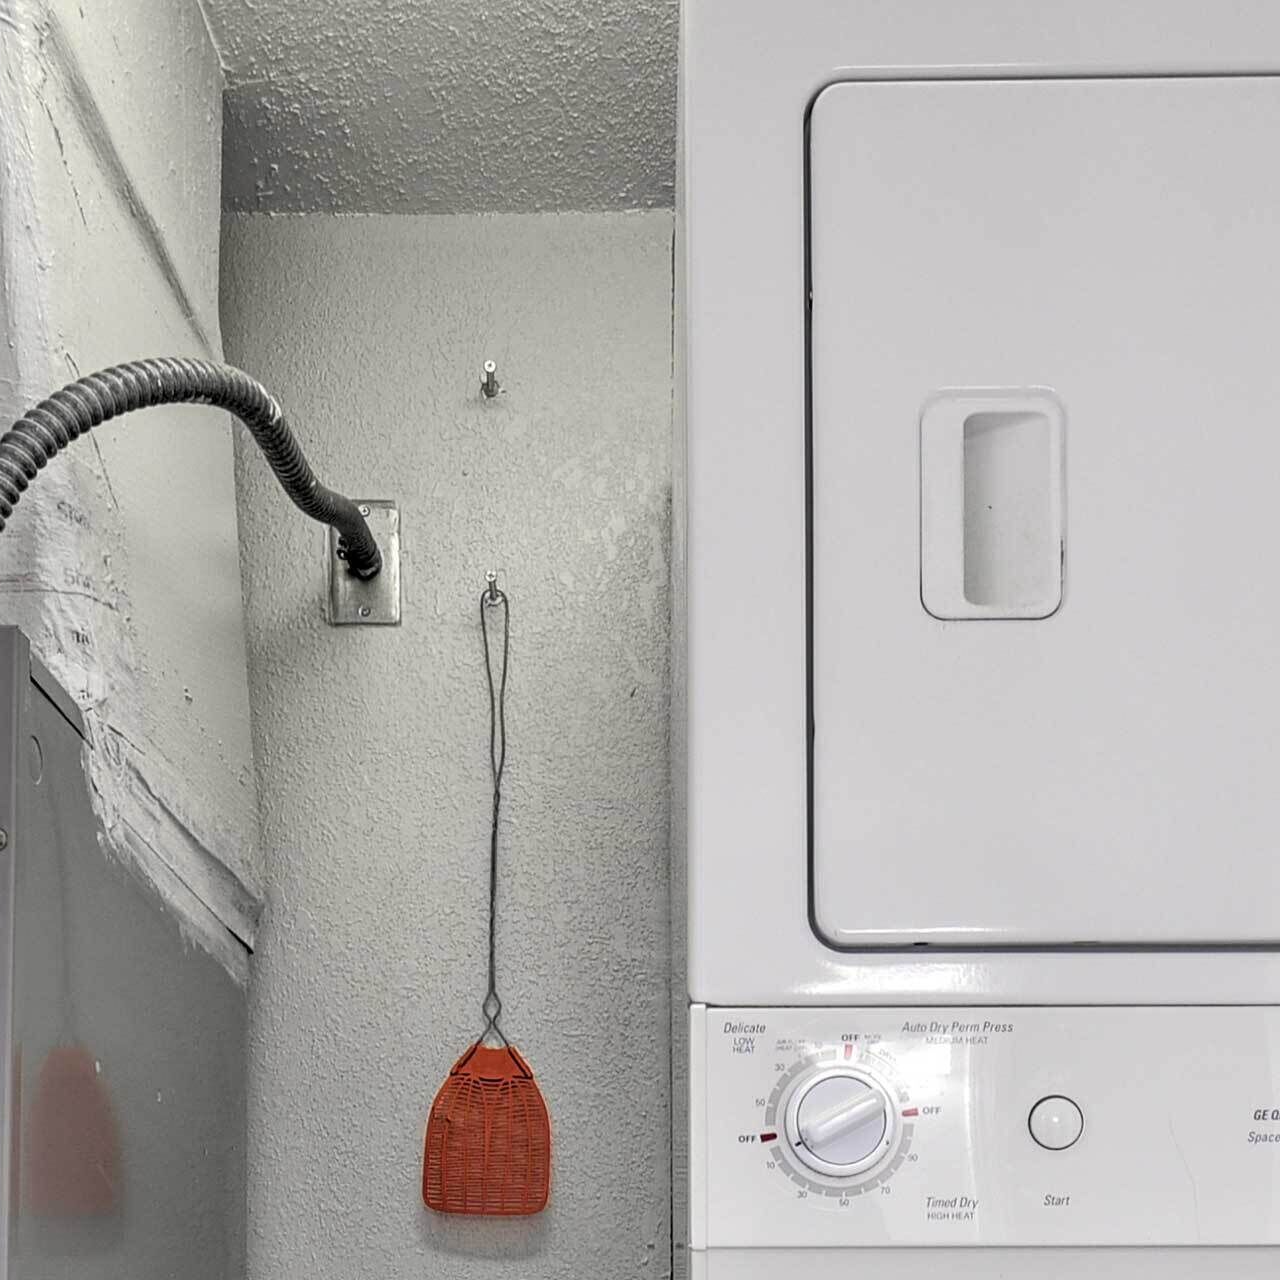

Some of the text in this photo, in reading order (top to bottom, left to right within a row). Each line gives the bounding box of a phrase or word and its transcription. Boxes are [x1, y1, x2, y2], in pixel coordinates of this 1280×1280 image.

[723, 1022, 766, 1034] Delicate
[902, 1022, 1014, 1034] Auto Dry Perm Press
[733, 1037, 755, 1045] LOW
[966, 1037, 989, 1045] HEAT
[922, 1107, 942, 1115] OFF
[1253, 1109, 1268, 1120] GE
[738, 1135, 756, 1143] OFF
[880, 1186, 890, 1195] 70
[926, 1197, 978, 1211] Timed Dry
[1044, 1194, 1070, 1206] Start
[927, 1212, 975, 1220] HIGH HEAT
